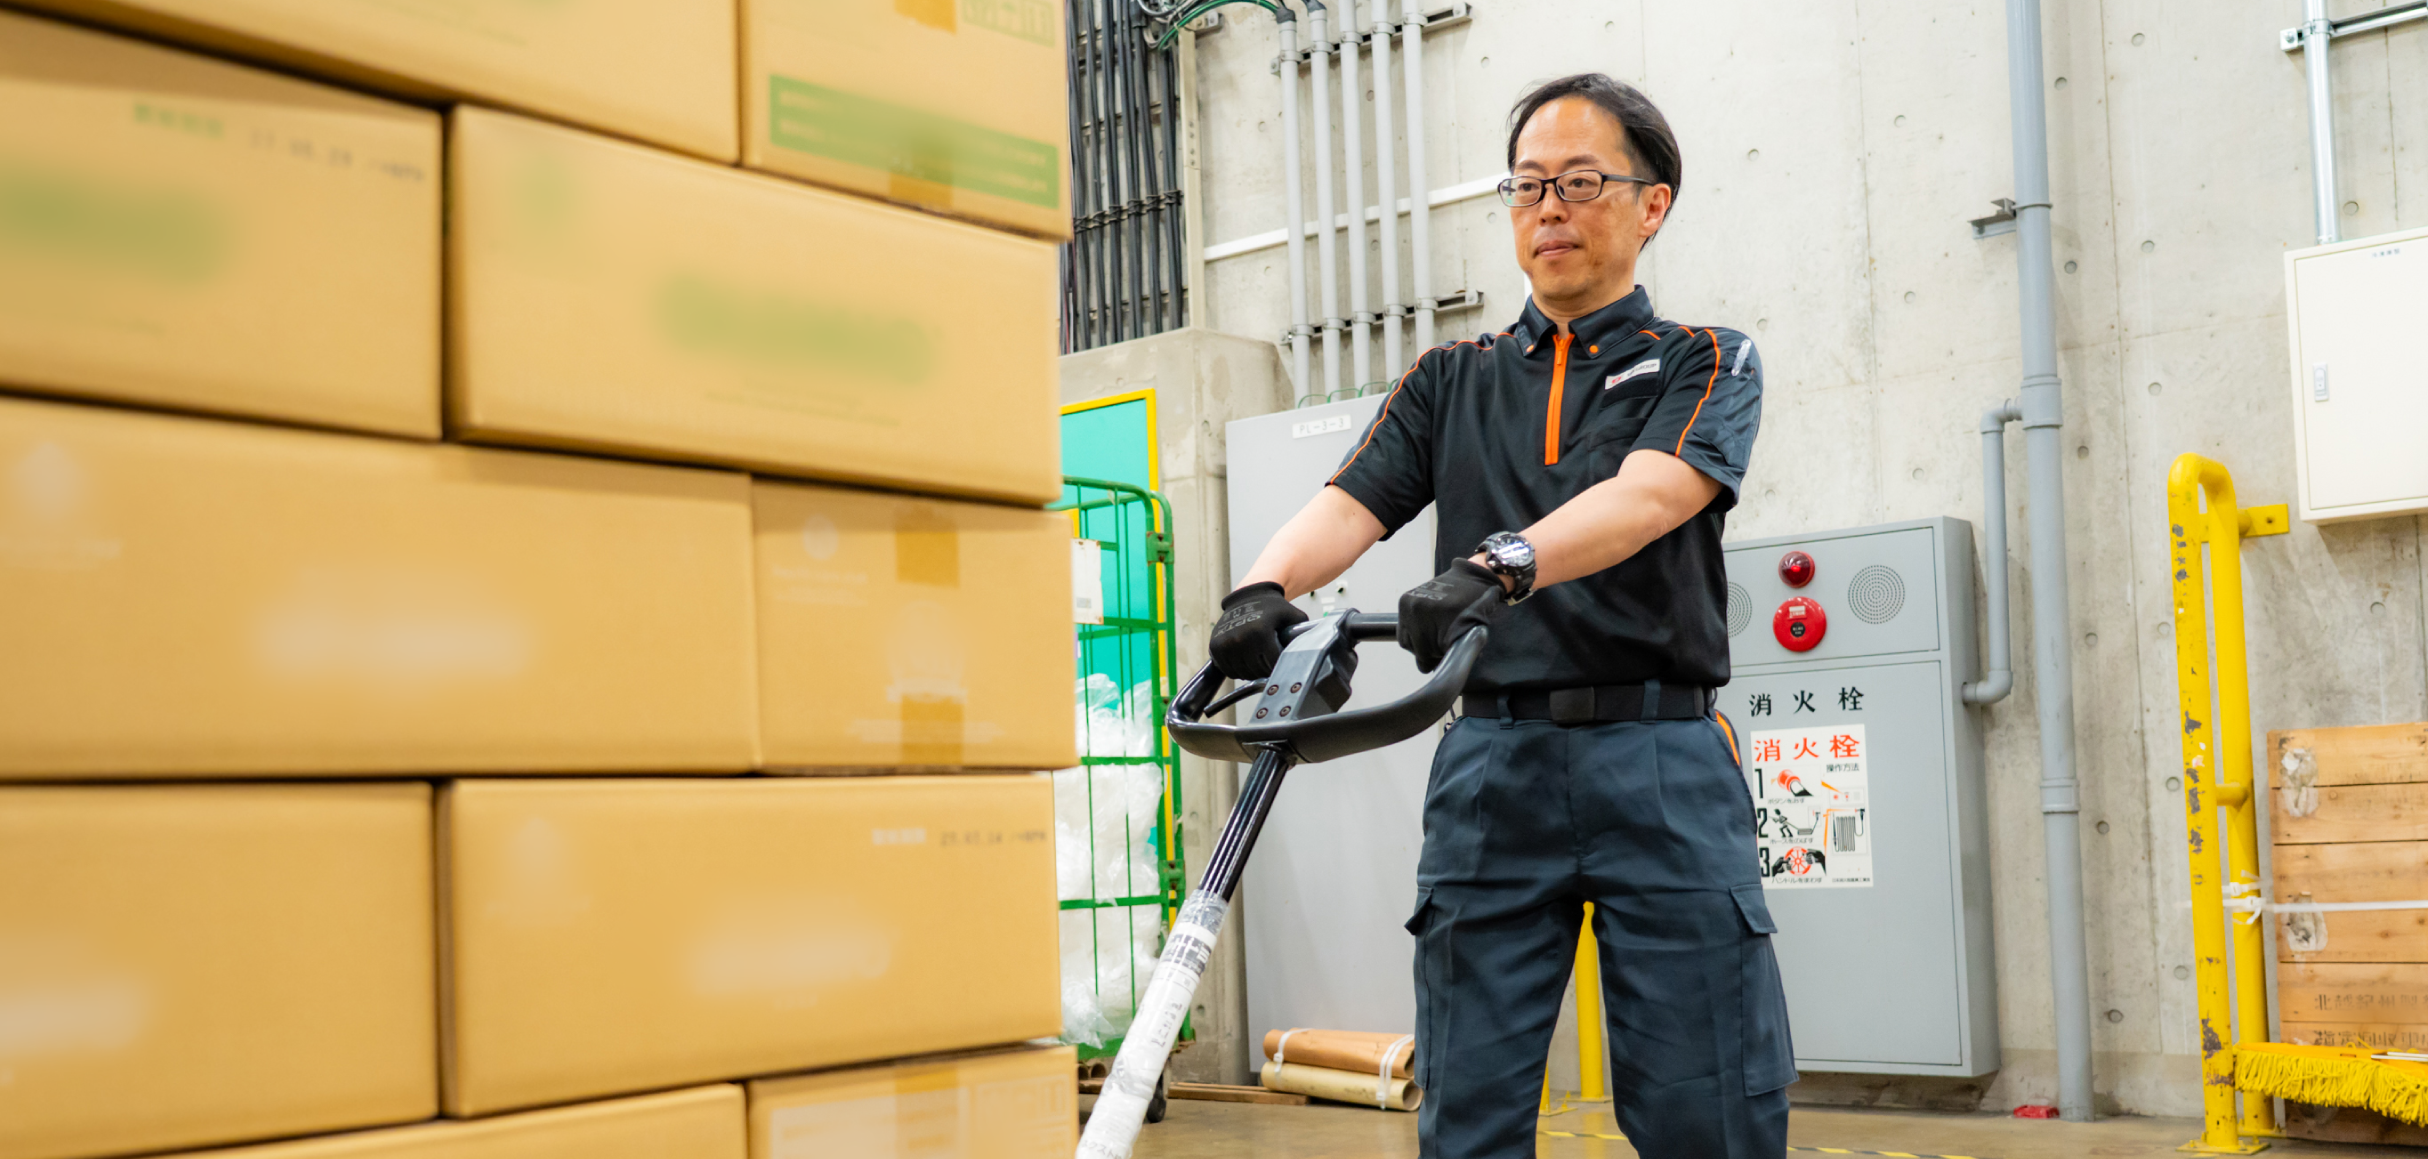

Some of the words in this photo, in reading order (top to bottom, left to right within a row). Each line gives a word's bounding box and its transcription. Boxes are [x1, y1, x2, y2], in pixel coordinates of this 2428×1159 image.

[1299, 417, 1344, 434] PL-3-3
[1748, 686, 1864, 717] 消火栓
[1754, 734, 1860, 762] 消火栓
[1825, 763, 1860, 773] 操作方法
[1754, 768, 1763, 799] 1
[1757, 808, 1769, 838] 2
[1759, 847, 1770, 877] 3
